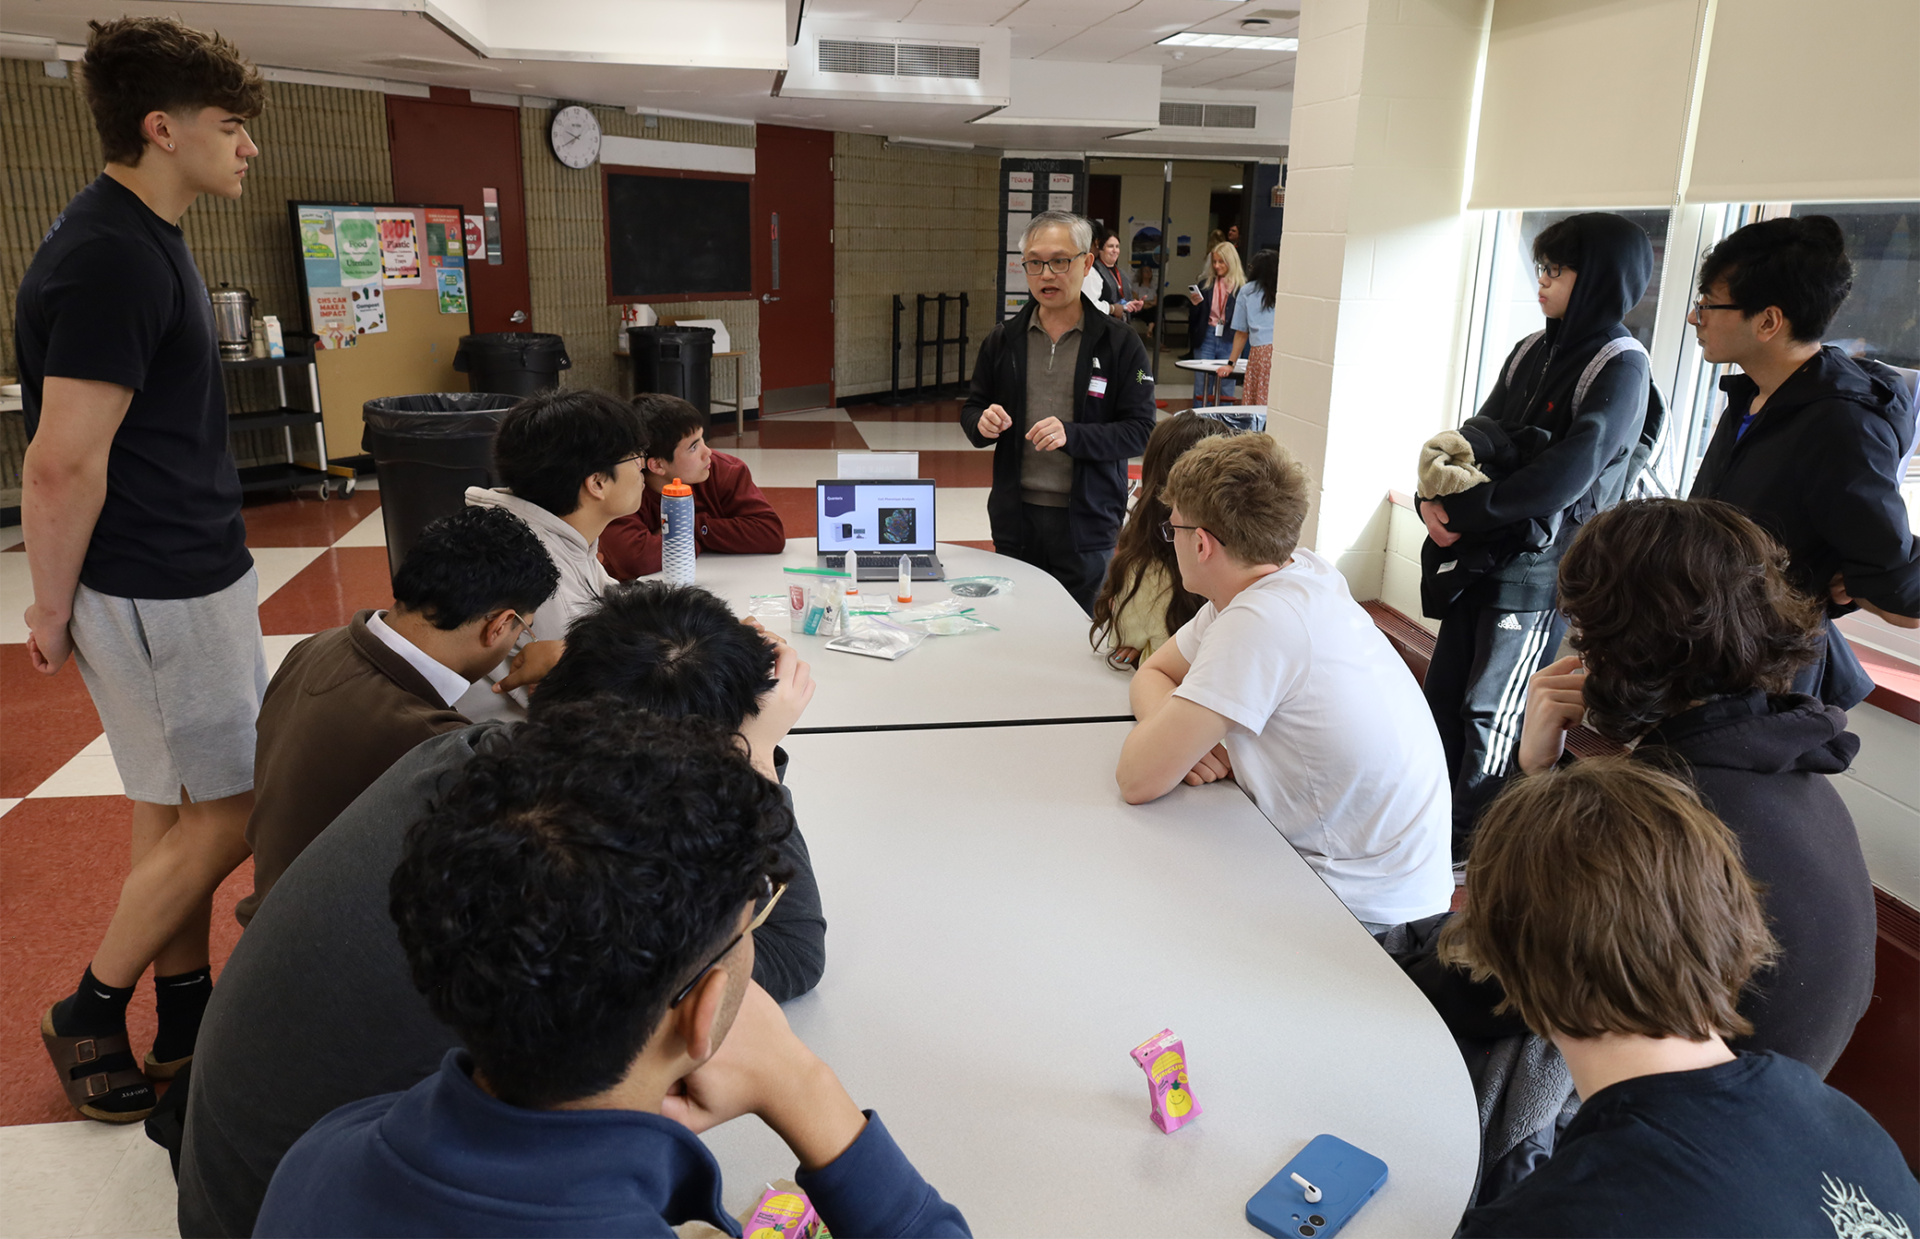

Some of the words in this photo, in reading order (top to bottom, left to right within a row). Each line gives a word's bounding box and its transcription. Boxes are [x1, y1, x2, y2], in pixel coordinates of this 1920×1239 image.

[1023, 161, 1060, 172] SPONSORS
[382, 220, 411, 239] NOT
[349, 240, 368, 248] Food
[387, 240, 410, 249] Plastic
[346, 259, 373, 267] Utensils
[761, 1206, 802, 1218] SUNCUP
